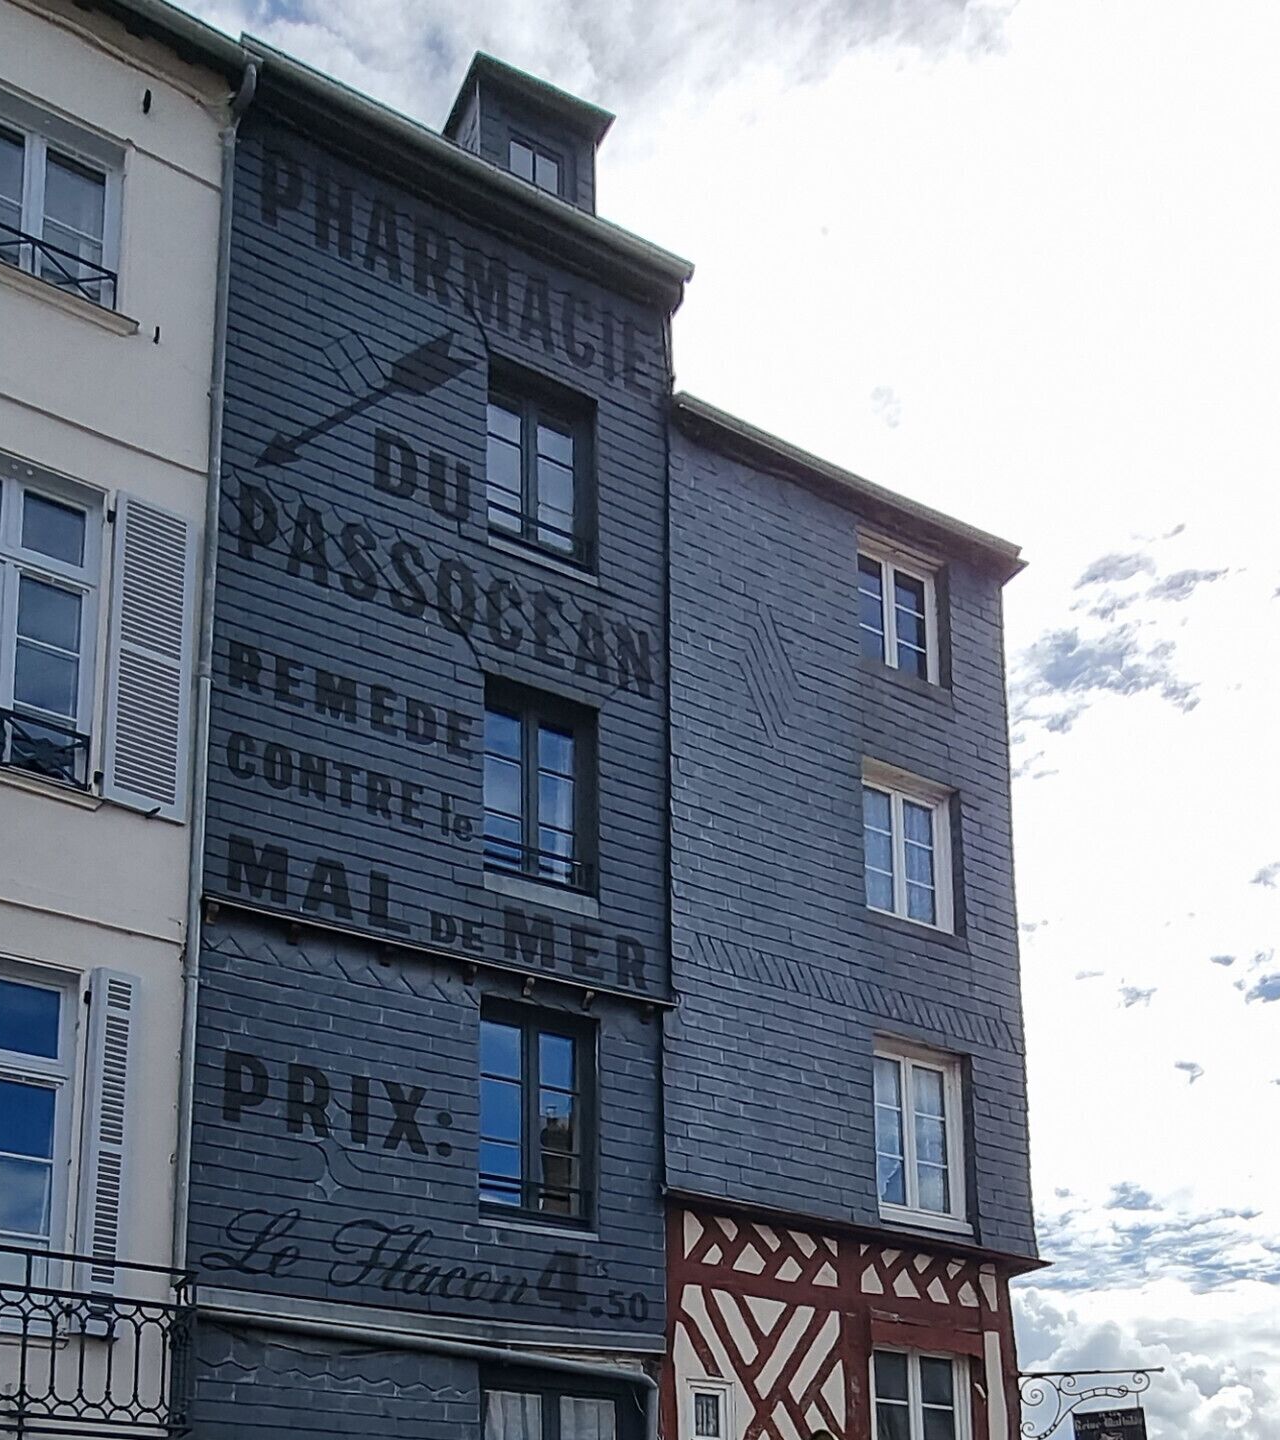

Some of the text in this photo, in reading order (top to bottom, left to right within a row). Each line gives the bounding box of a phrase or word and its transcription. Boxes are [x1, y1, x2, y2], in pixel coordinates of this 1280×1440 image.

[259, 146, 654, 393] PHARMACIE
[373, 428, 471, 523] DU
[237, 480, 657, 698] PASSOCEAN
[228, 642, 474, 758] REMEDE
[227, 732, 424, 829] CONTRE
[226, 834, 648, 990] MAL DE MER
[222, 1048, 454, 1158] PRIX:
[200, 1207, 302, 1279] Le
[329, 1218, 528, 1306] Flacon
